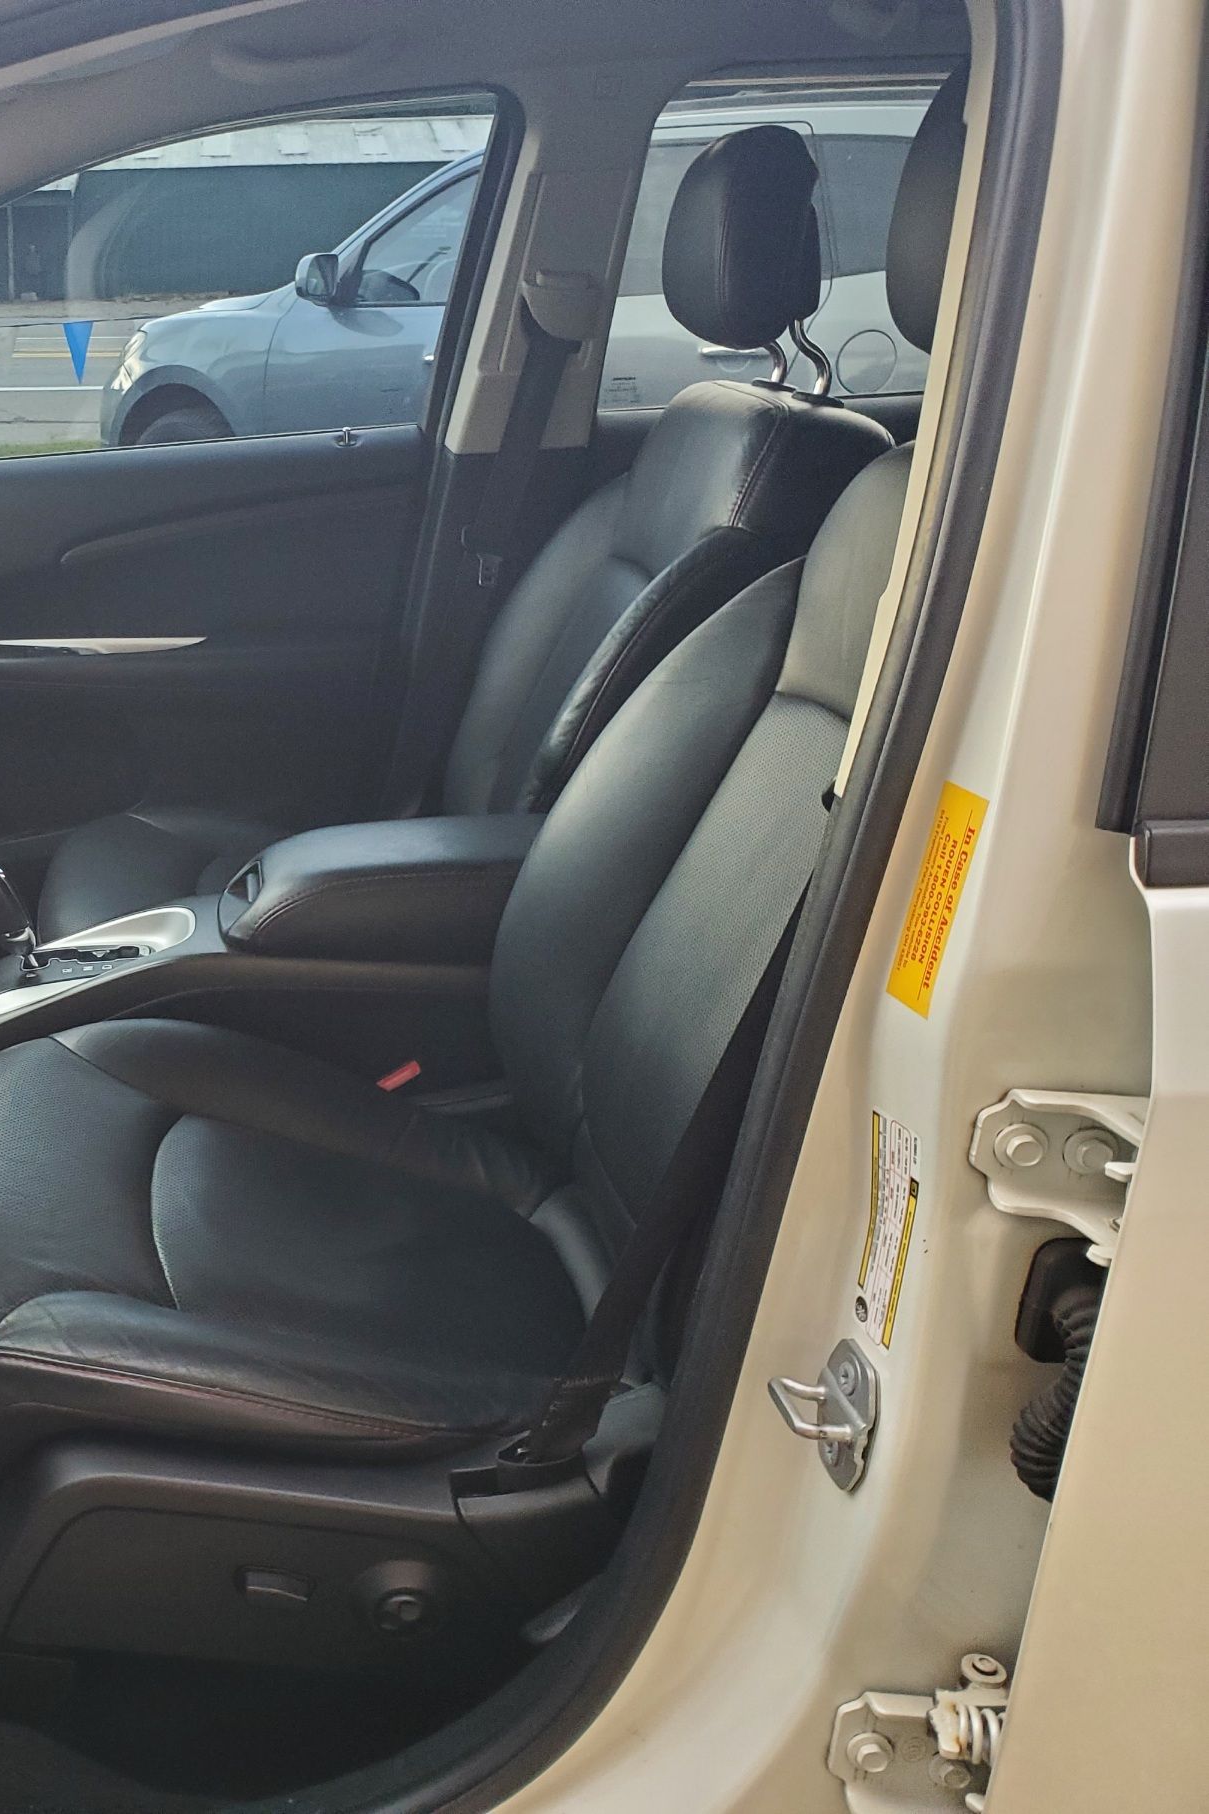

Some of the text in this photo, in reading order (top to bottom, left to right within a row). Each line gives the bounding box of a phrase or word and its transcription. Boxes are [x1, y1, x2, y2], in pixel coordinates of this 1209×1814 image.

[939, 833, 951, 860] Call
[918, 839, 958, 964] ROUEN COLLISION
[923, 827, 975, 989] In Case of Accident
[902, 959, 909, 968] to
